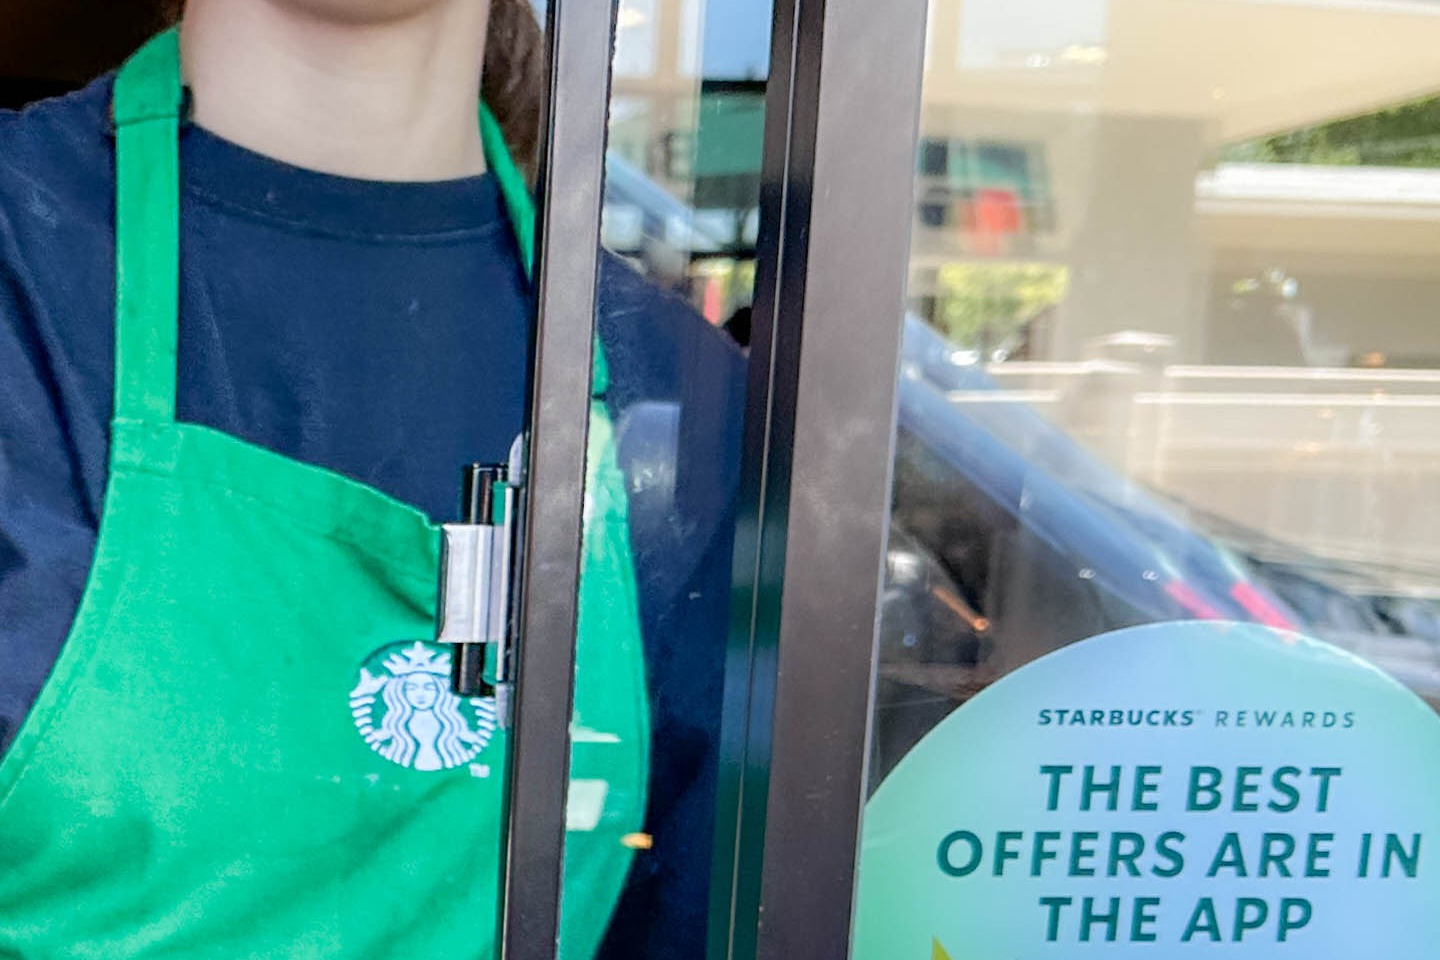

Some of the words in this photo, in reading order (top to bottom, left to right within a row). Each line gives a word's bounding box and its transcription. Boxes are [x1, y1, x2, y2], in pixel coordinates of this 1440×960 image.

[1037, 709, 1195, 727] STARBUCKS
[1214, 710, 1356, 728] REWARDS
[1039, 765, 1162, 811] THE
[1186, 766, 1343, 812] BEST
[936, 831, 1185, 877] OFFERS
[1206, 833, 1334, 878] ARE
[1357, 834, 1422, 878] IN
[1039, 897, 1162, 941] THE
[1180, 898, 1313, 942] APP
